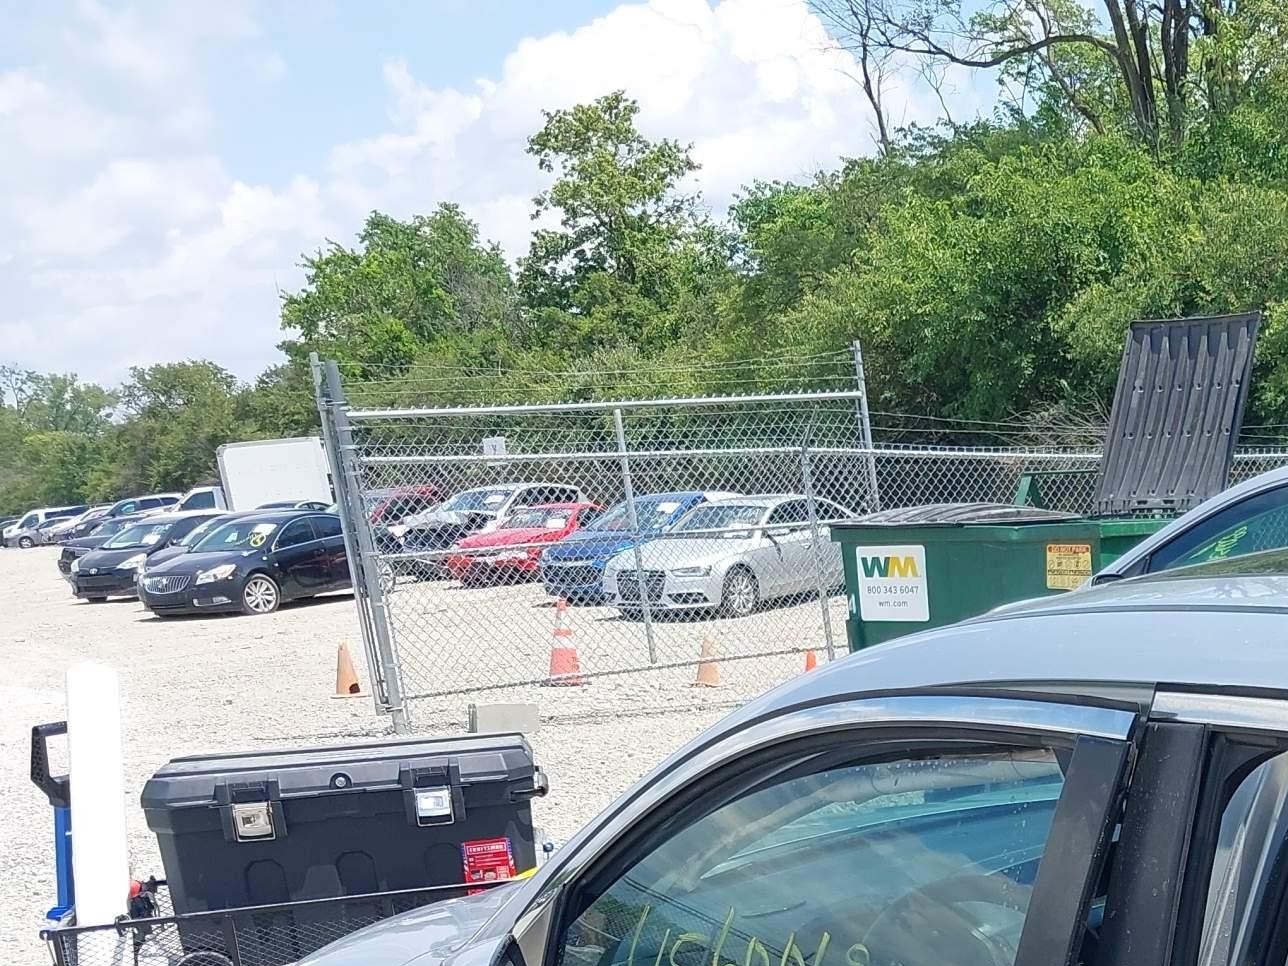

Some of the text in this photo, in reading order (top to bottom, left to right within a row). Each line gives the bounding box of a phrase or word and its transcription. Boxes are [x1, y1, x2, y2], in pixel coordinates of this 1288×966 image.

[861, 556, 919, 578] WM
[867, 585, 919, 594] 800 343 6047
[878, 600, 908, 608] wm.com
